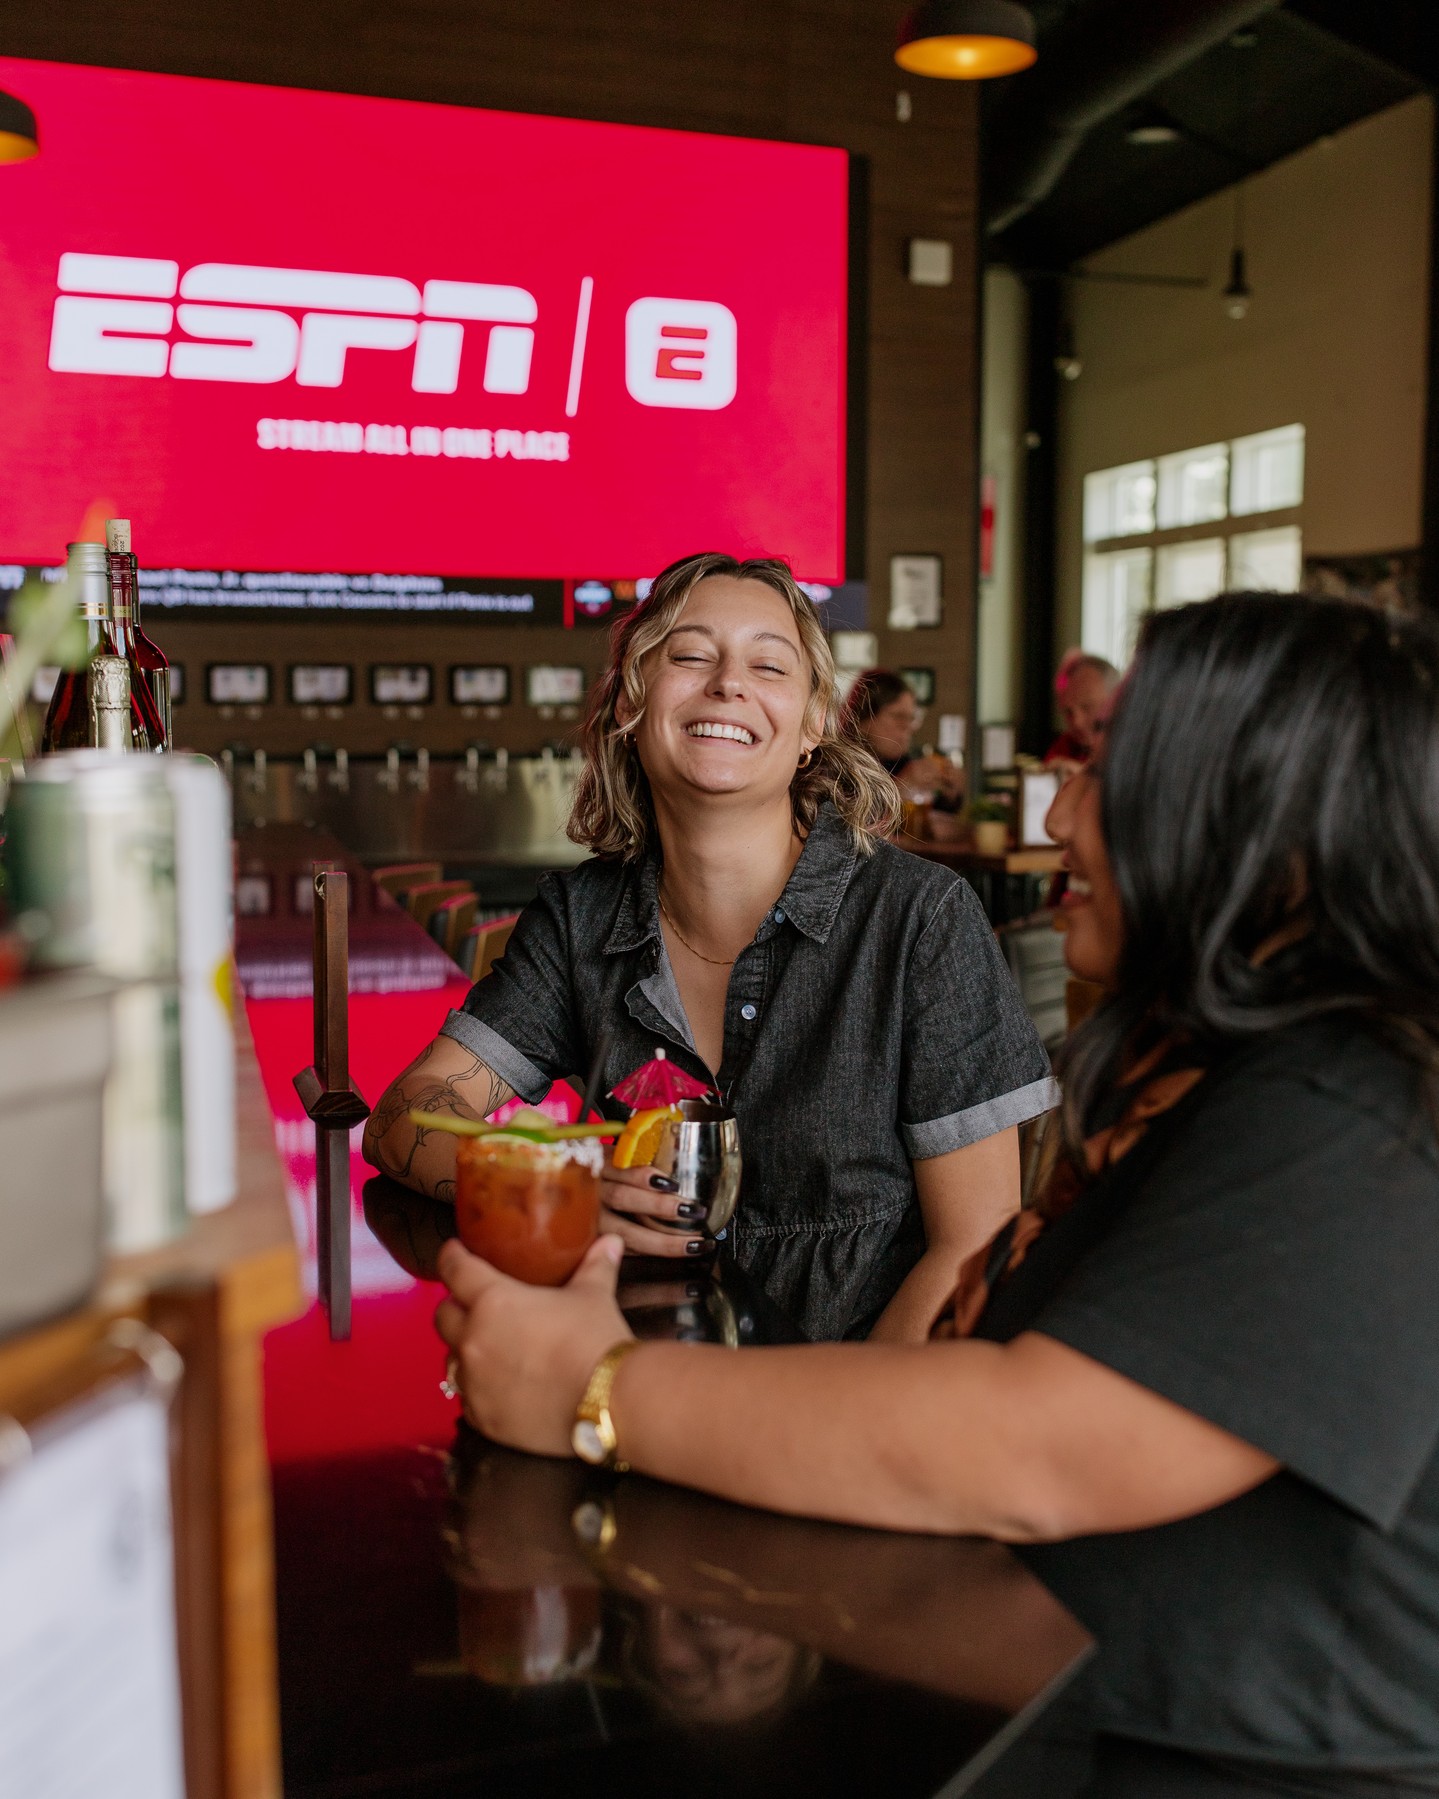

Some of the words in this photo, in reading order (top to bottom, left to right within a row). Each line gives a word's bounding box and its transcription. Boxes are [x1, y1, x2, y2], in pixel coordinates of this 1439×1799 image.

[48, 252, 538, 395] ESPN
[257, 417, 363, 453] STREAM
[365, 423, 408, 456] ALL
[410, 426, 441, 457] IN
[442, 427, 492, 460] ONE
[494, 428, 570, 462] PLACE
